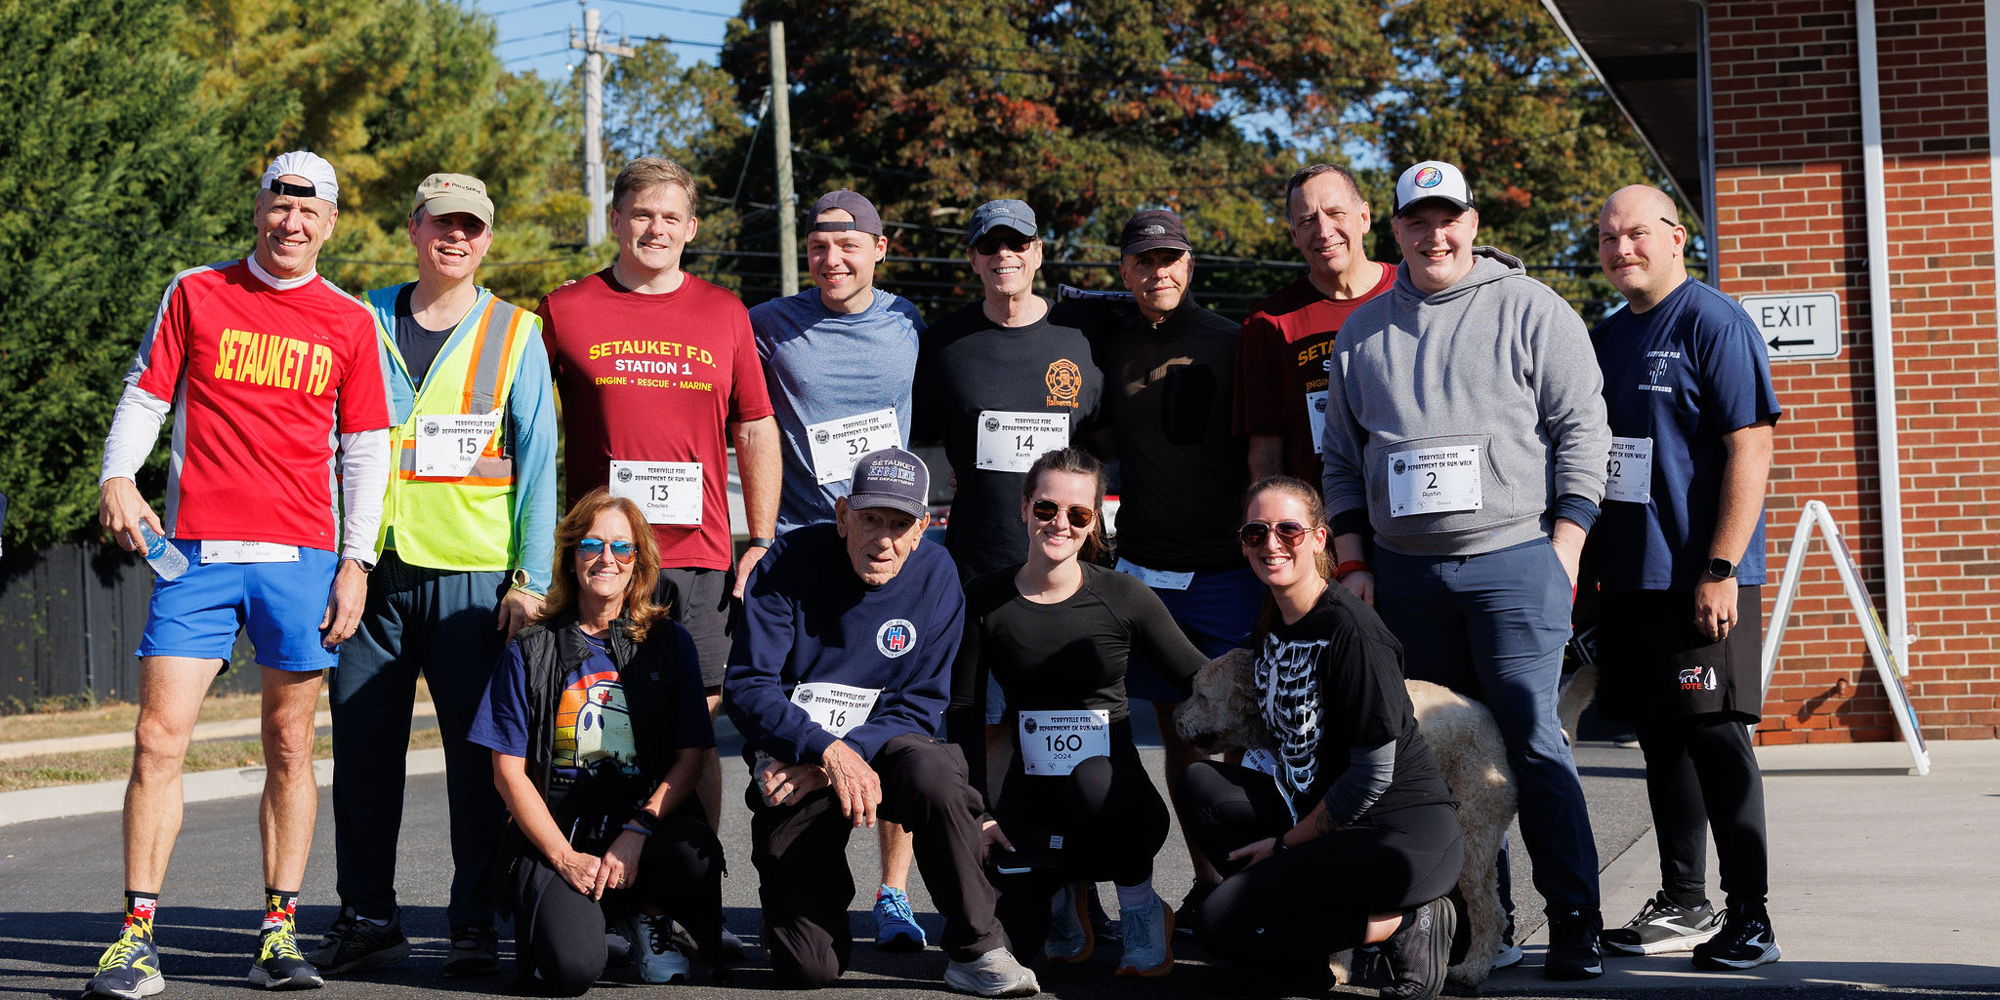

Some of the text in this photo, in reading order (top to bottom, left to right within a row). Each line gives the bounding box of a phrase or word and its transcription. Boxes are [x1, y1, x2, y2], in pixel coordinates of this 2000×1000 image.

[1762, 304, 1816, 327] EXIT
[214, 328, 333, 396] SETAUKET FD
[588, 340, 717, 368] SETAUKET F.D.
[615, 359, 693, 375] STATION 1
[595, 376, 713, 392] ENGINE RESCUE MARINE
[458, 438, 477, 454] 15
[846, 437, 870, 455] 32
[1016, 435, 1034, 450] 14
[871, 459, 916, 471] SETAUKET
[879, 477, 915, 487] DEPARTMENT
[1426, 472, 1438, 489] 2
[650, 485, 669, 501] 13
[829, 709, 847, 727] 16
[1045, 734, 1082, 752] 160
